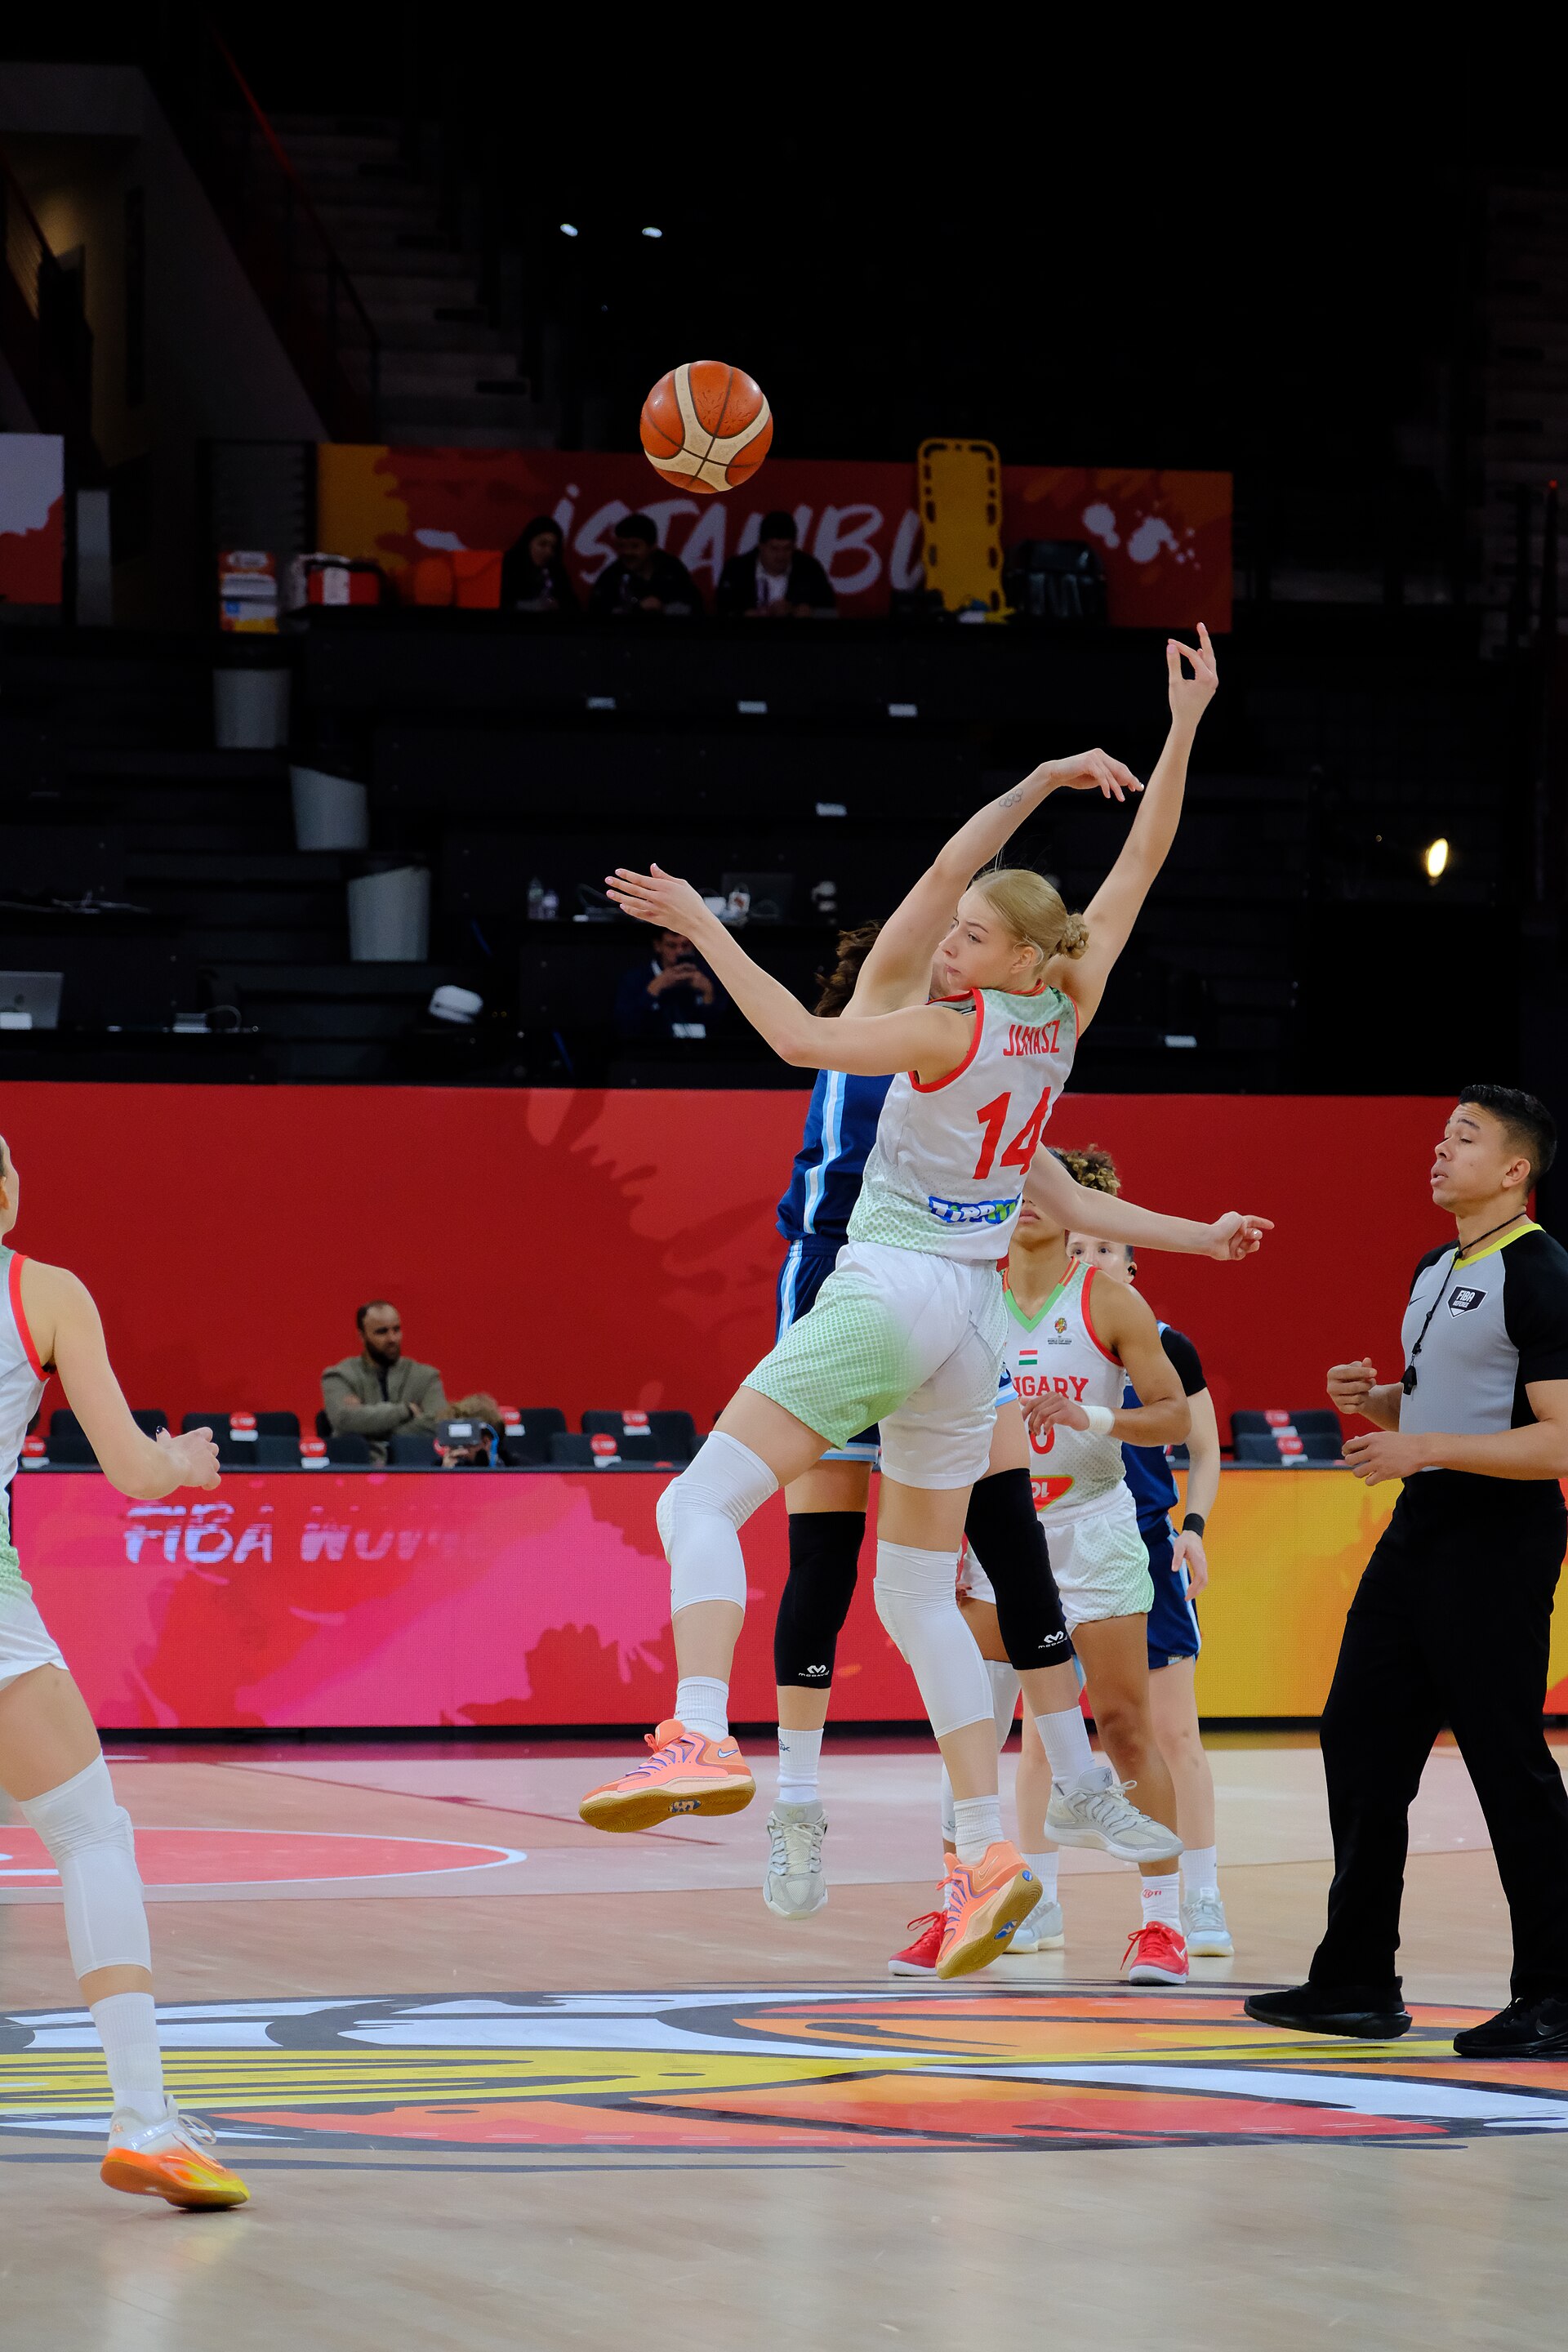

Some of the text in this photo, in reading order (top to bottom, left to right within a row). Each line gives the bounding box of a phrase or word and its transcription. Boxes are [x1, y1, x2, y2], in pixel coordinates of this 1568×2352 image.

[972, 1086, 1052, 1180] 14
[1456, 1290, 1476, 1303] FIBA
[1013, 1376, 1089, 1402] NGARY
[123, 1502, 273, 1563] FIBA
